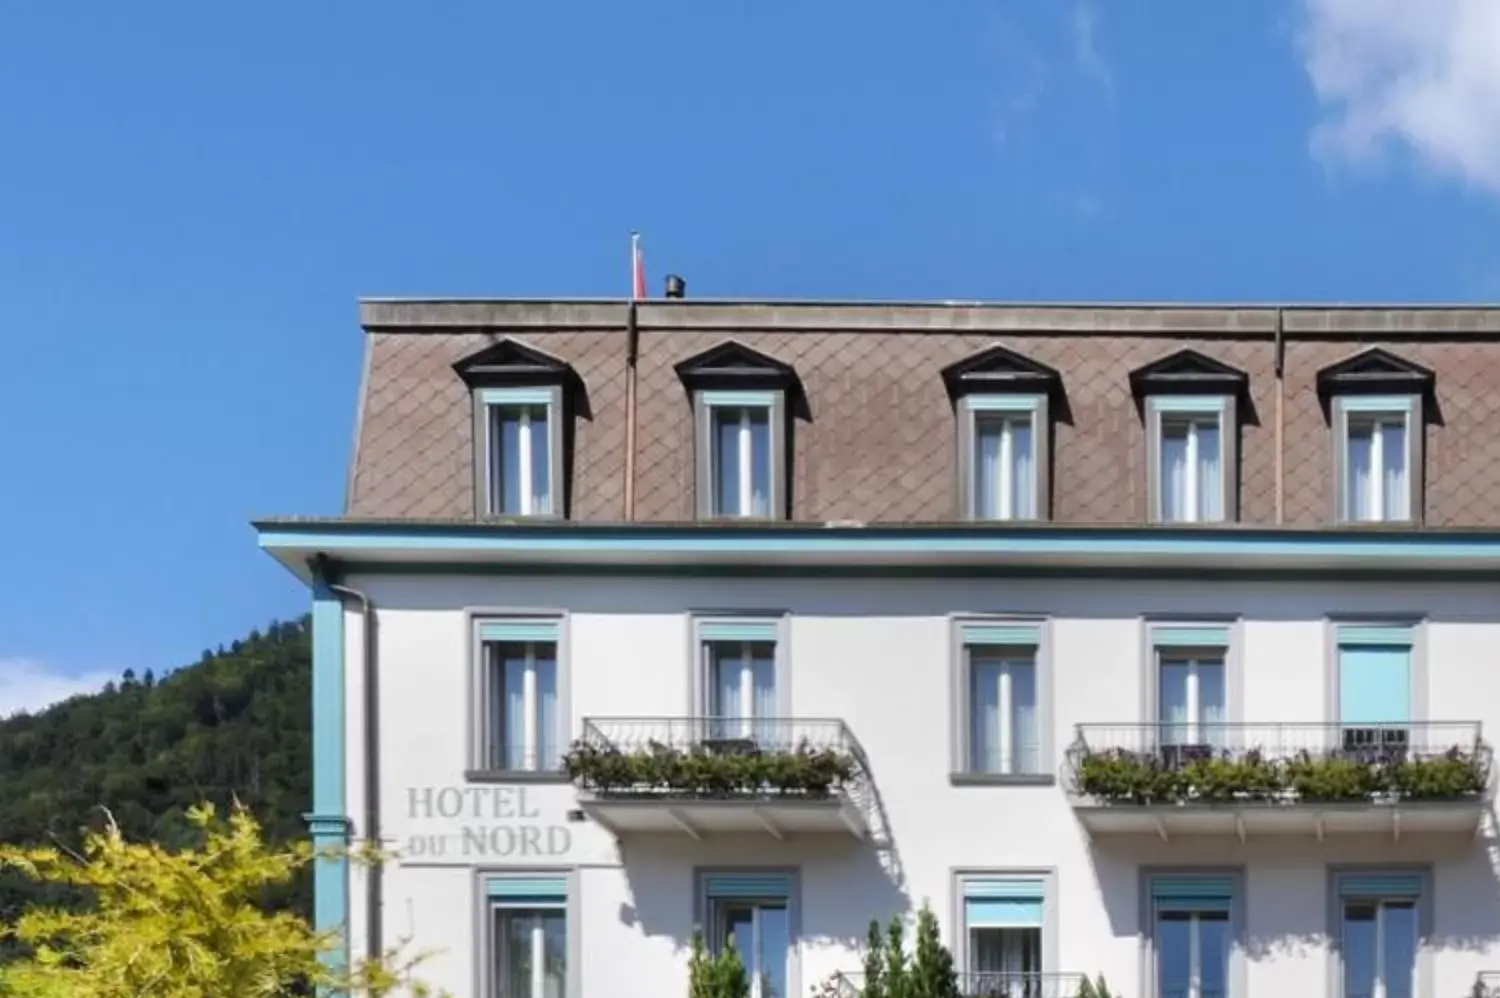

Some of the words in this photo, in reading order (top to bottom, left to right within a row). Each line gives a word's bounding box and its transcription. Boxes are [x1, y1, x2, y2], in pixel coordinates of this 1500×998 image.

[407, 786, 541, 818] HOTEL
[408, 835, 447, 857] DU
[461, 825, 573, 857] NORD
